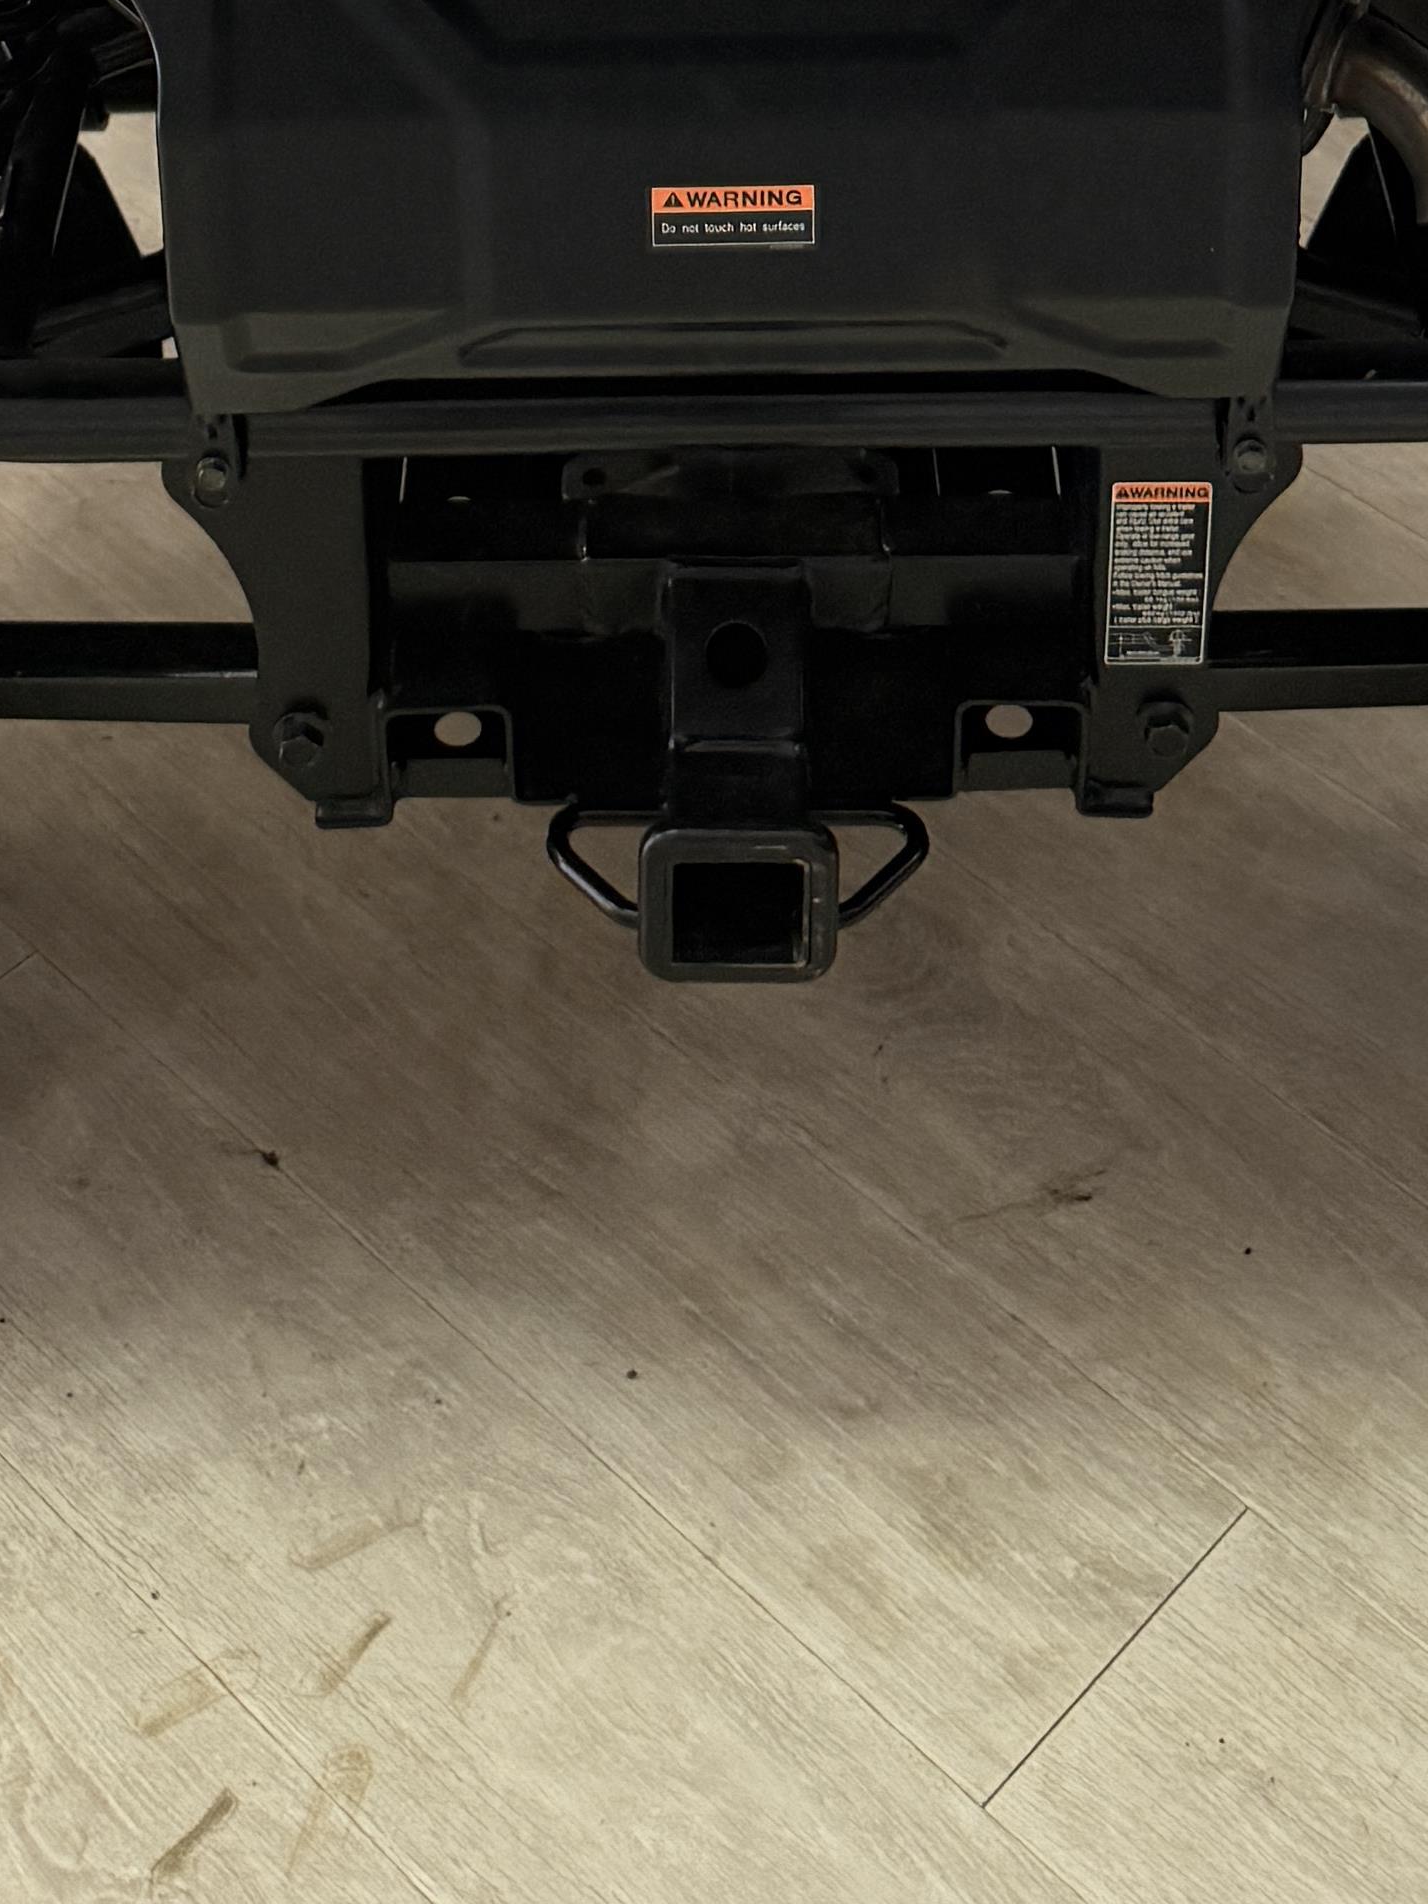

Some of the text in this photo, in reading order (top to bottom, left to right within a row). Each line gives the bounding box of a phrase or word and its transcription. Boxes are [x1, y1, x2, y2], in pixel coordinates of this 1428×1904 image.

[686, 190, 802, 208] WARNING
[662, 221, 805, 234] Do not touch hot surfaces
[1130, 487, 1208, 498] WARNING
